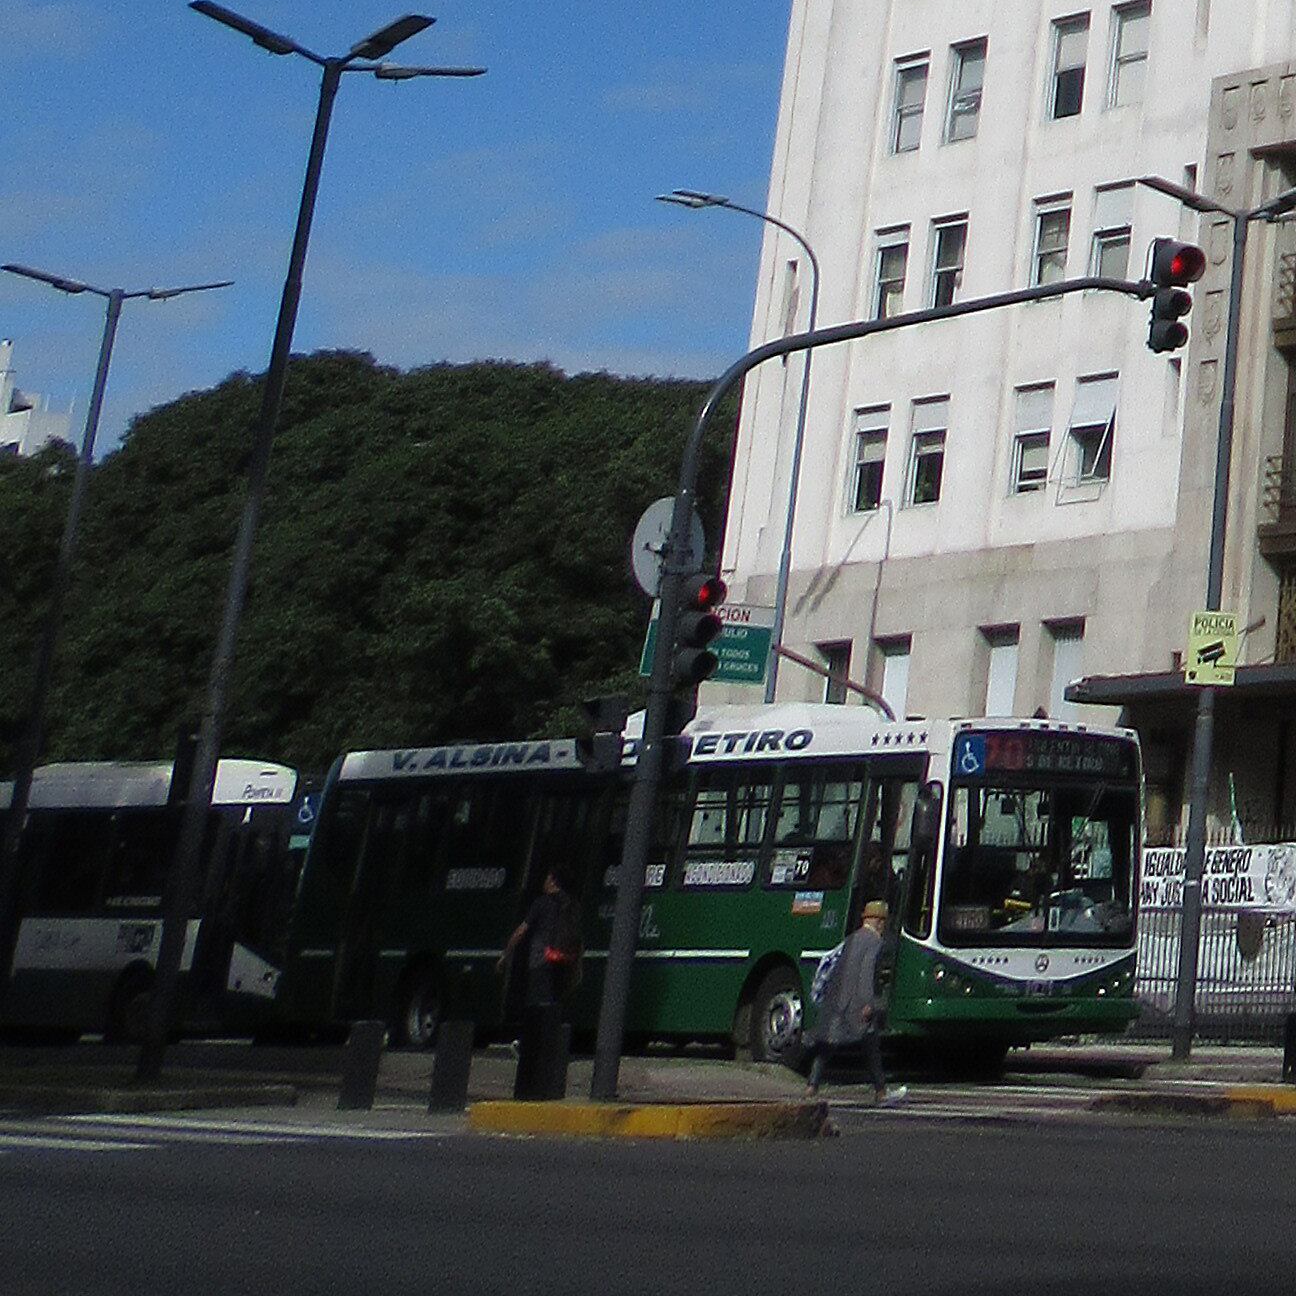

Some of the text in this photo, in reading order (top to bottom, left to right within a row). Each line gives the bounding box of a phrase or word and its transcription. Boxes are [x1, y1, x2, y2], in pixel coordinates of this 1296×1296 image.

[693, 728, 815, 756] ETIRO
[1211, 848, 1251, 875] GENERO
[1212, 876, 1255, 904] SOCIAL
